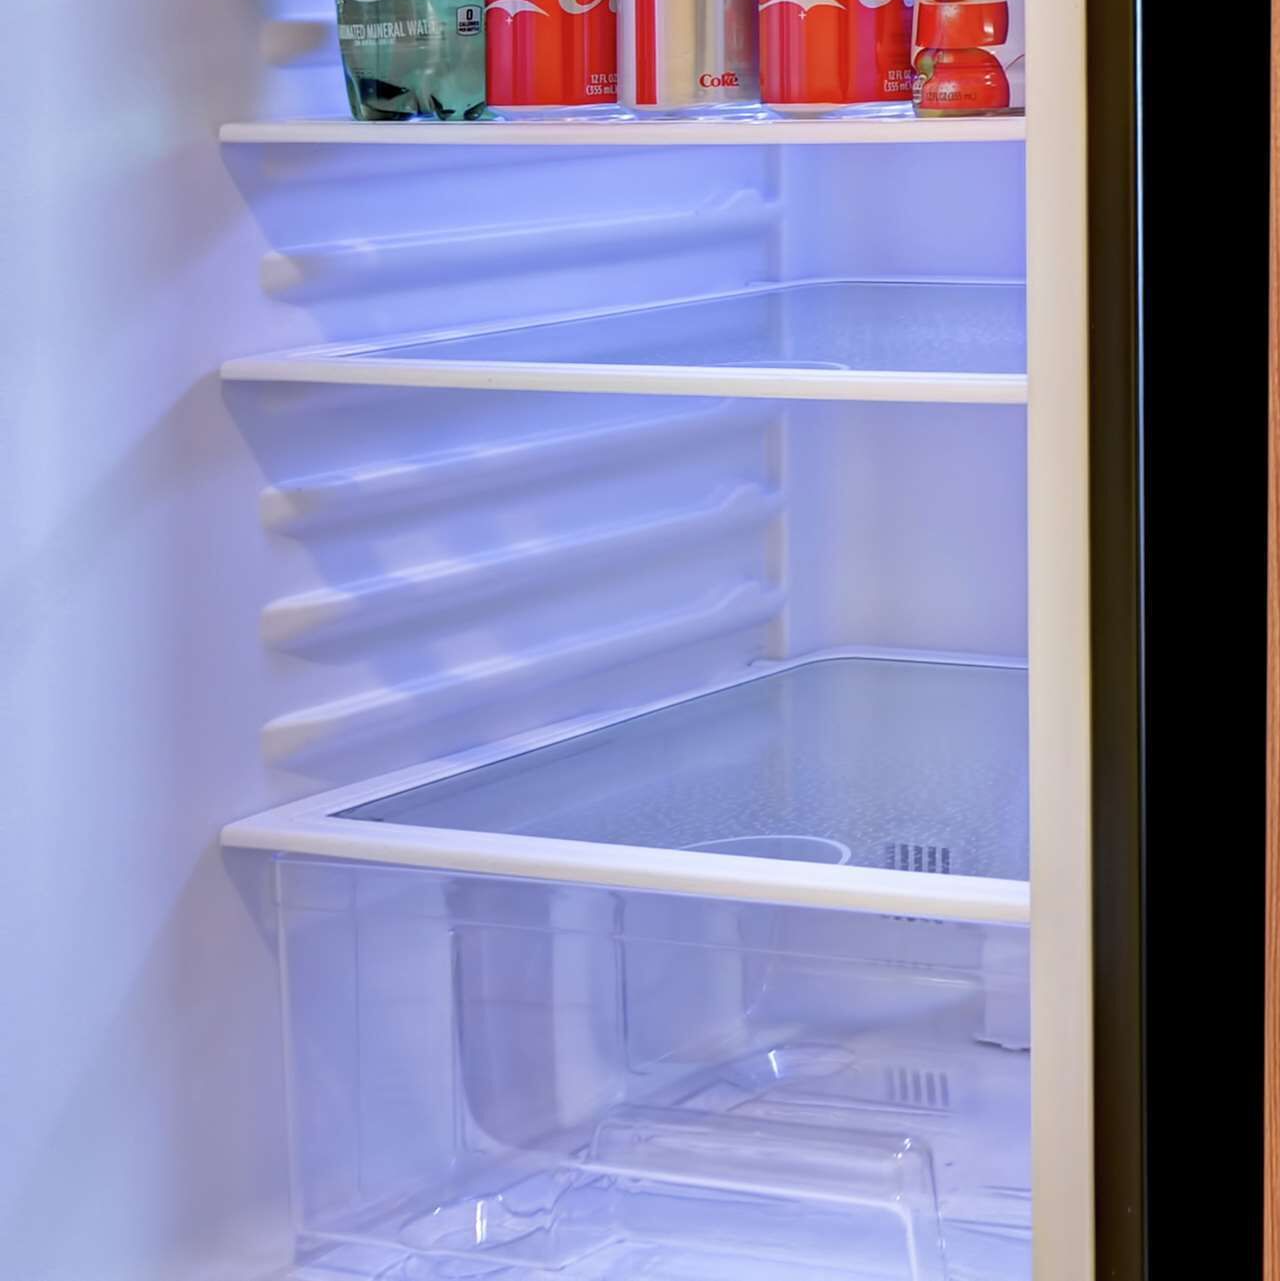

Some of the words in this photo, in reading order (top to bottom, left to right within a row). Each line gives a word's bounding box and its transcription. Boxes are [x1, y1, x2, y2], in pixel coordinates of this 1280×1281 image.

[466, 9, 473, 20] 0
[366, 22, 406, 38] MINERAL
[700, 72, 739, 88] Coke
